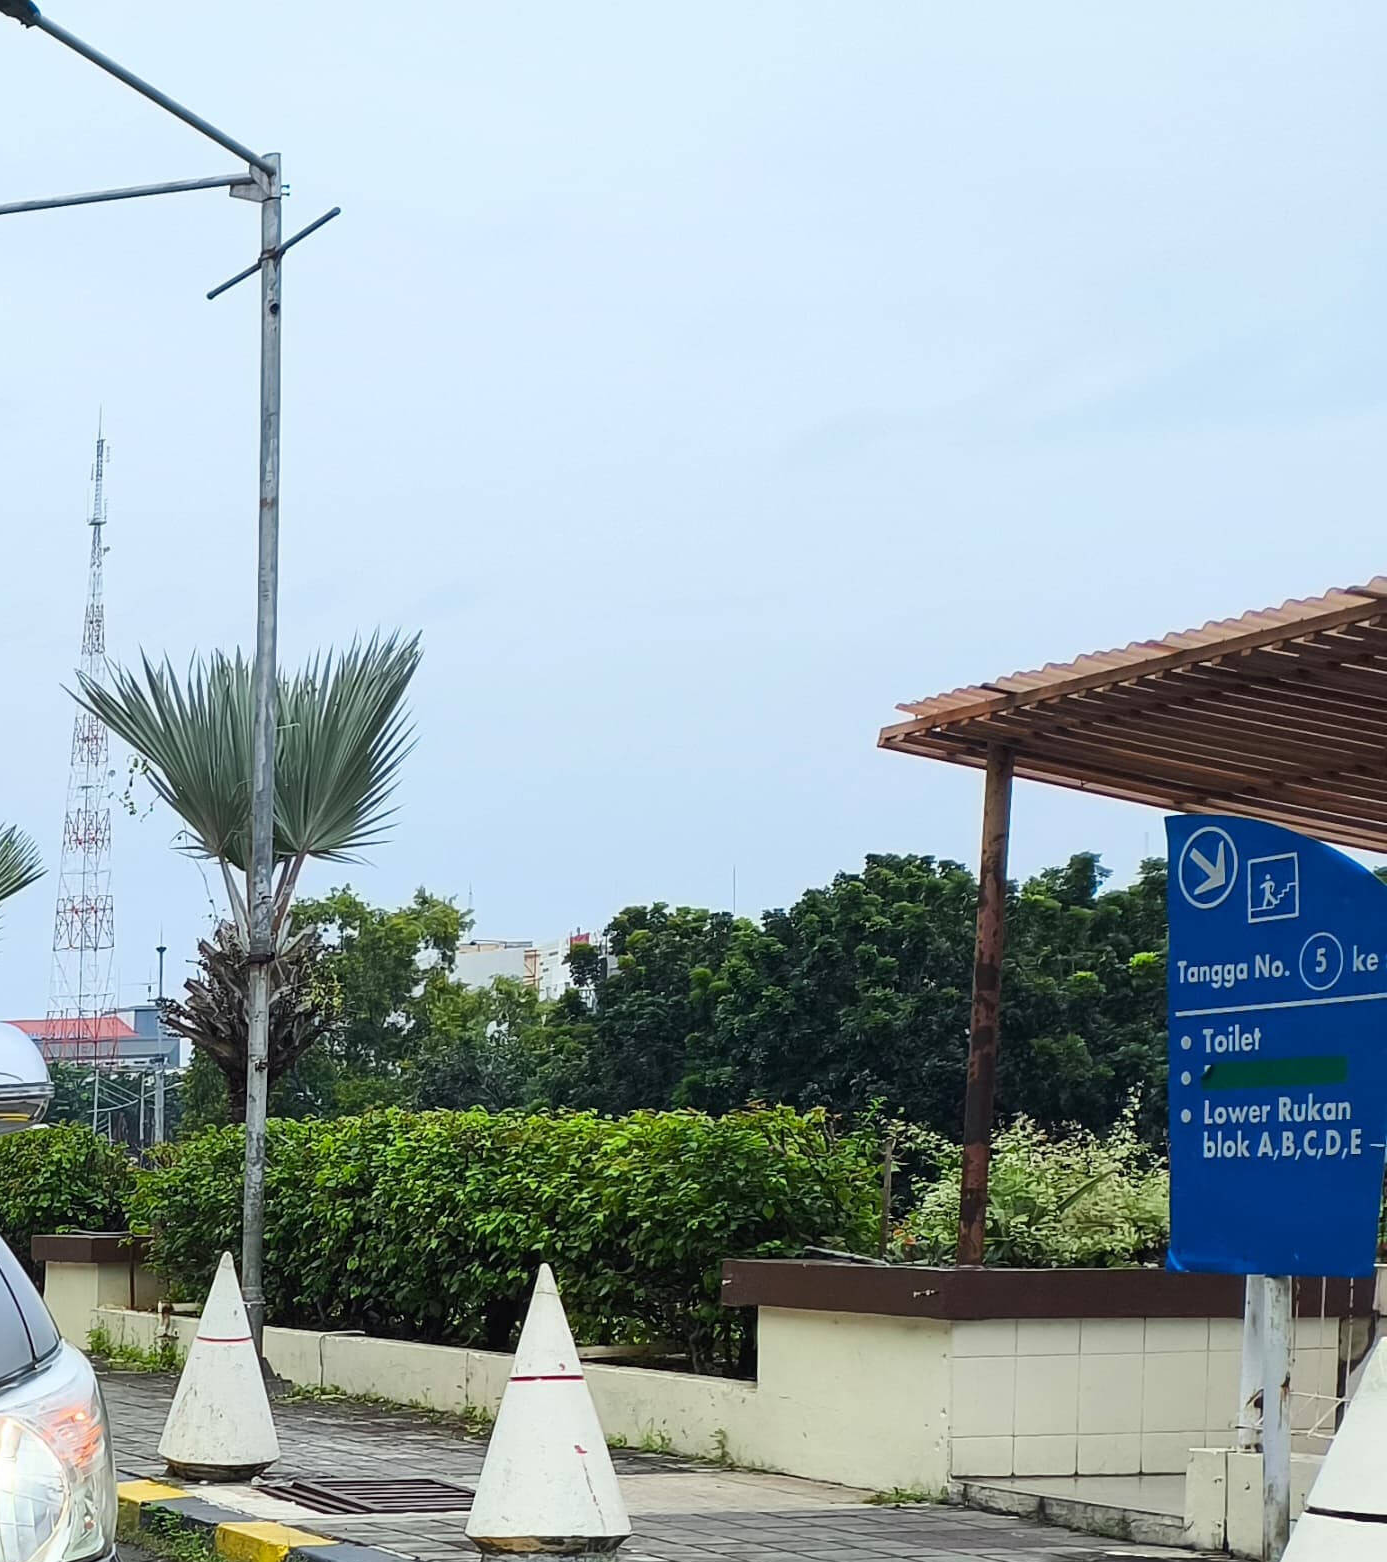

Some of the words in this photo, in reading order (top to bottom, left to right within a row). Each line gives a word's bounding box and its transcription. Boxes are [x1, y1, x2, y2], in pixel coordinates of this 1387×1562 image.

[1177, 961, 1248, 989] Tangga
[1255, 954, 1290, 979] No.
[1315, 948, 1327, 973] 5
[1352, 945, 1379, 973] ke
[1202, 1024, 1262, 1053] Toilet
[1203, 1099, 1271, 1124] Lower
[1278, 1093, 1352, 1122] Rukan
[1203, 1130, 1251, 1159] blok
[1257, 1128, 1362, 1161] A,B,C,D,E
